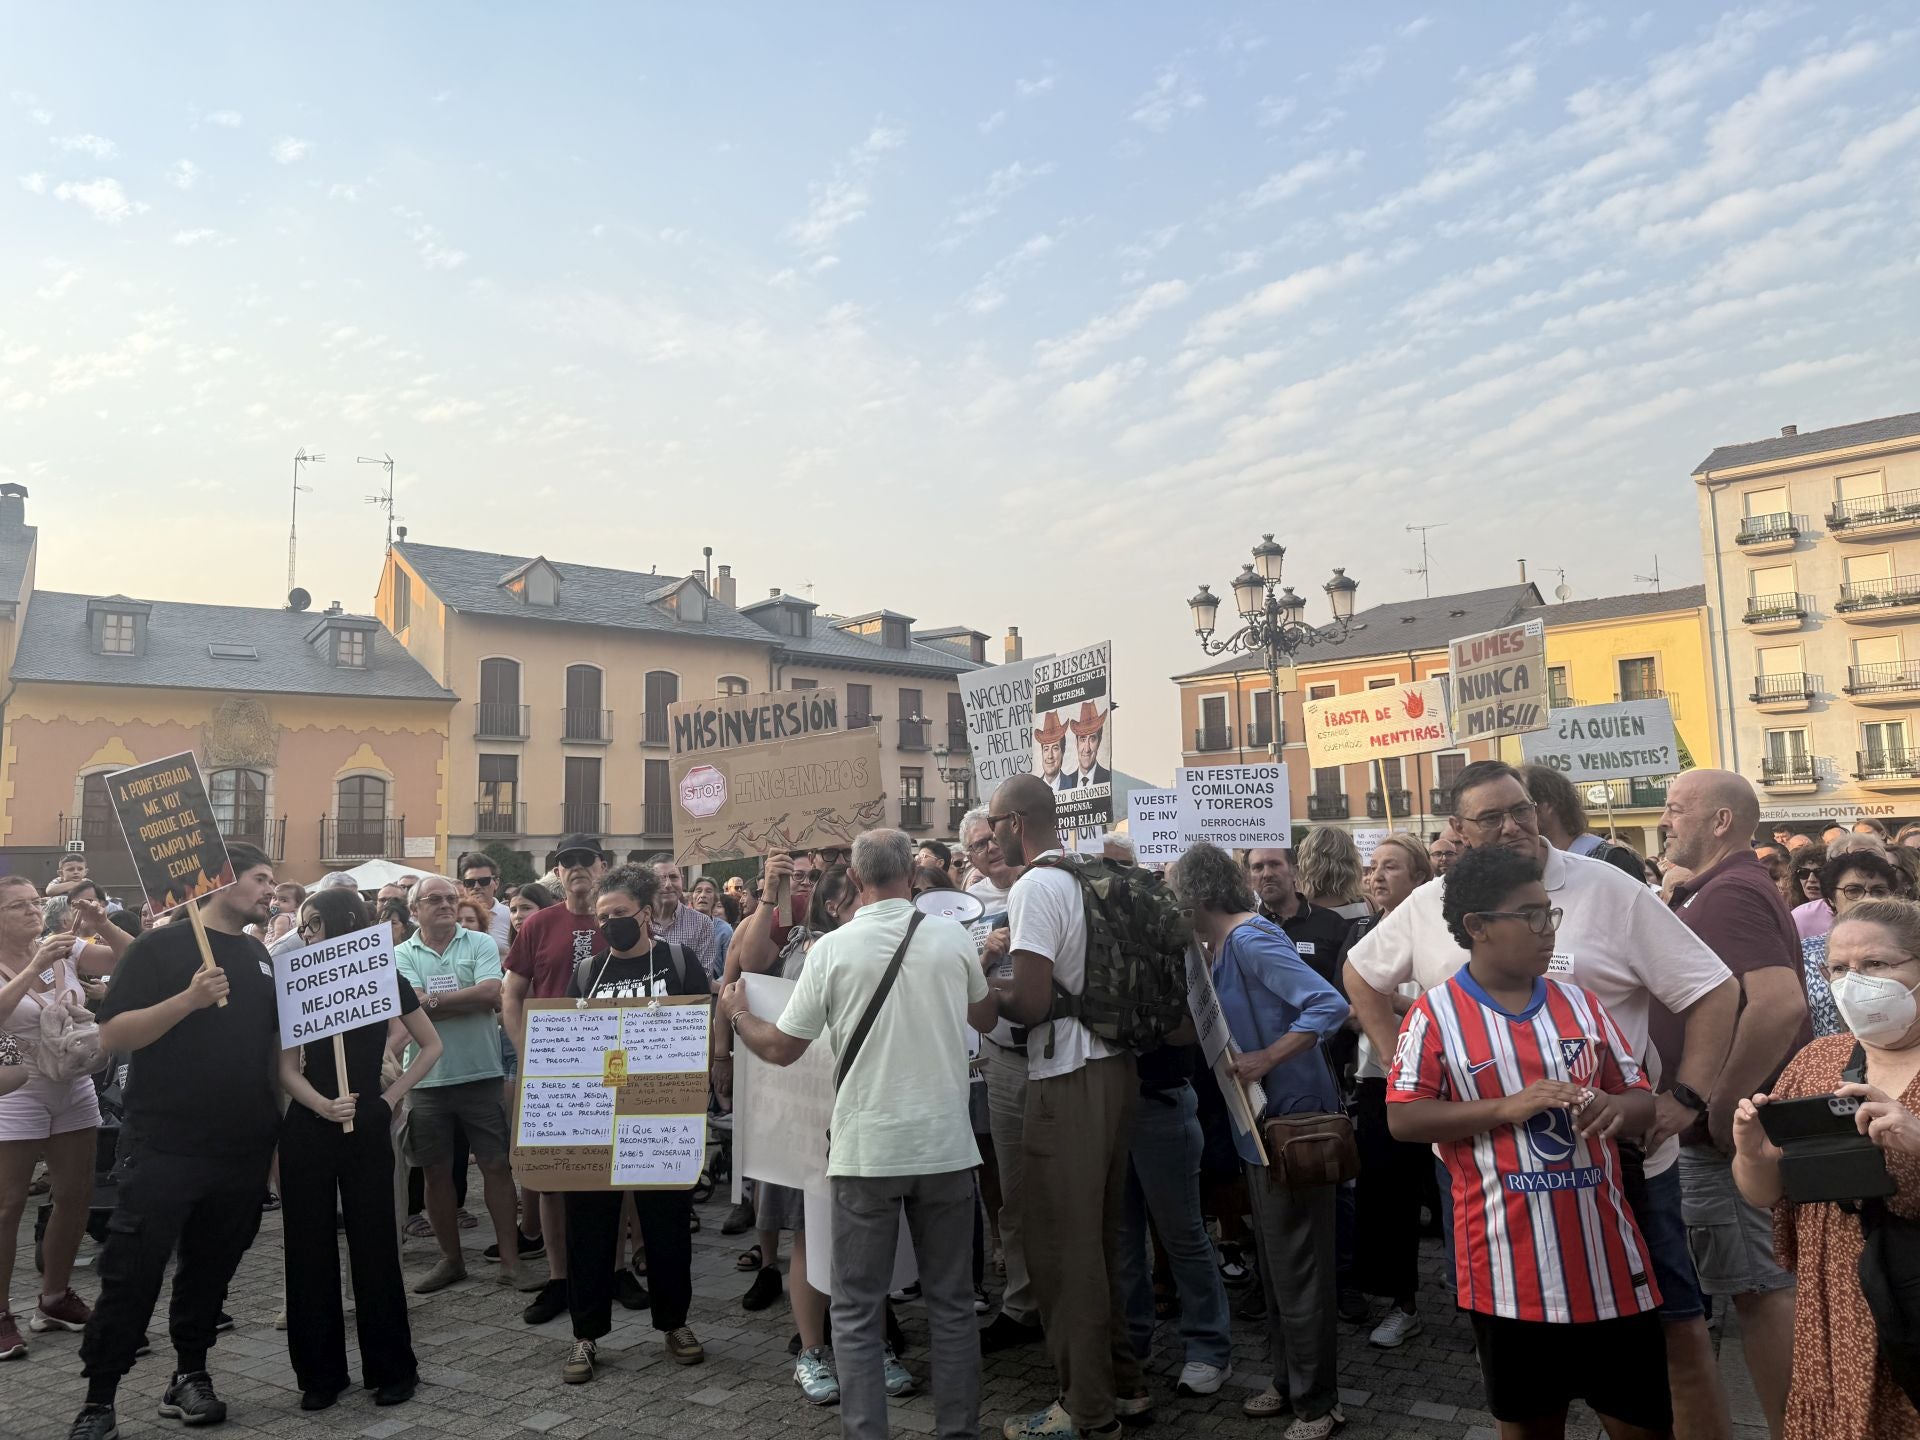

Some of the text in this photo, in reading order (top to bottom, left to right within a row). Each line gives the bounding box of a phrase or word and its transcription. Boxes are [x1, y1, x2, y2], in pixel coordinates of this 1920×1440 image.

[1457, 629, 1525, 668] LUMES
[1034, 646, 1107, 685] SE BUSCAN
[1036, 667, 1106, 696] POR NEGLIGENCIA
[1458, 663, 1530, 705] NUNCA
[970, 683, 1012, 711] NACHO
[1052, 687, 1086, 704] EXTREMA
[970, 708, 1007, 735] JAIME
[1375, 707, 1391, 722] DE
[987, 730, 1018, 756] ABEL
[1369, 722, 1446, 748] MENTIRAS!
[979, 759, 999, 781] en
[1534, 753, 1572, 772] NOS
[1578, 745, 1669, 770] VENDISTEIS?
[120, 766, 193, 802] A PONFERRADA
[735, 757, 869, 805] INCENDIOS
[1186, 767, 1279, 782] EN FESTEJOS
[684, 782, 723, 801] STOP
[1070, 785, 1110, 801] QUIÑONES
[1191, 782, 1274, 796] COMILONAS
[142, 791, 181, 817] ME VOY
[1140, 811, 1155, 821] DE
[1193, 797, 1273, 810] Y TOREROS
[1819, 805, 1895, 817] HONTANAR
[140, 809, 200, 842] PORQUE DEL
[1058, 811, 1107, 829] POR ELLOS
[1201, 816, 1266, 827] DERROCHÁIS
[150, 829, 205, 862] CAMPO ME
[1184, 833, 1285, 842] NUESTROS DINEROS
[167, 853, 202, 879] ECHAN
[290, 933, 381, 973] BOMBEROS
[286, 952, 389, 995] FORESTALES
[301, 980, 378, 1016] MEJORAS
[292, 997, 392, 1039] SALARIALES
[682, 1125, 689, 1133] A
[1508, 1168, 1602, 1190] RIYADH AIR
